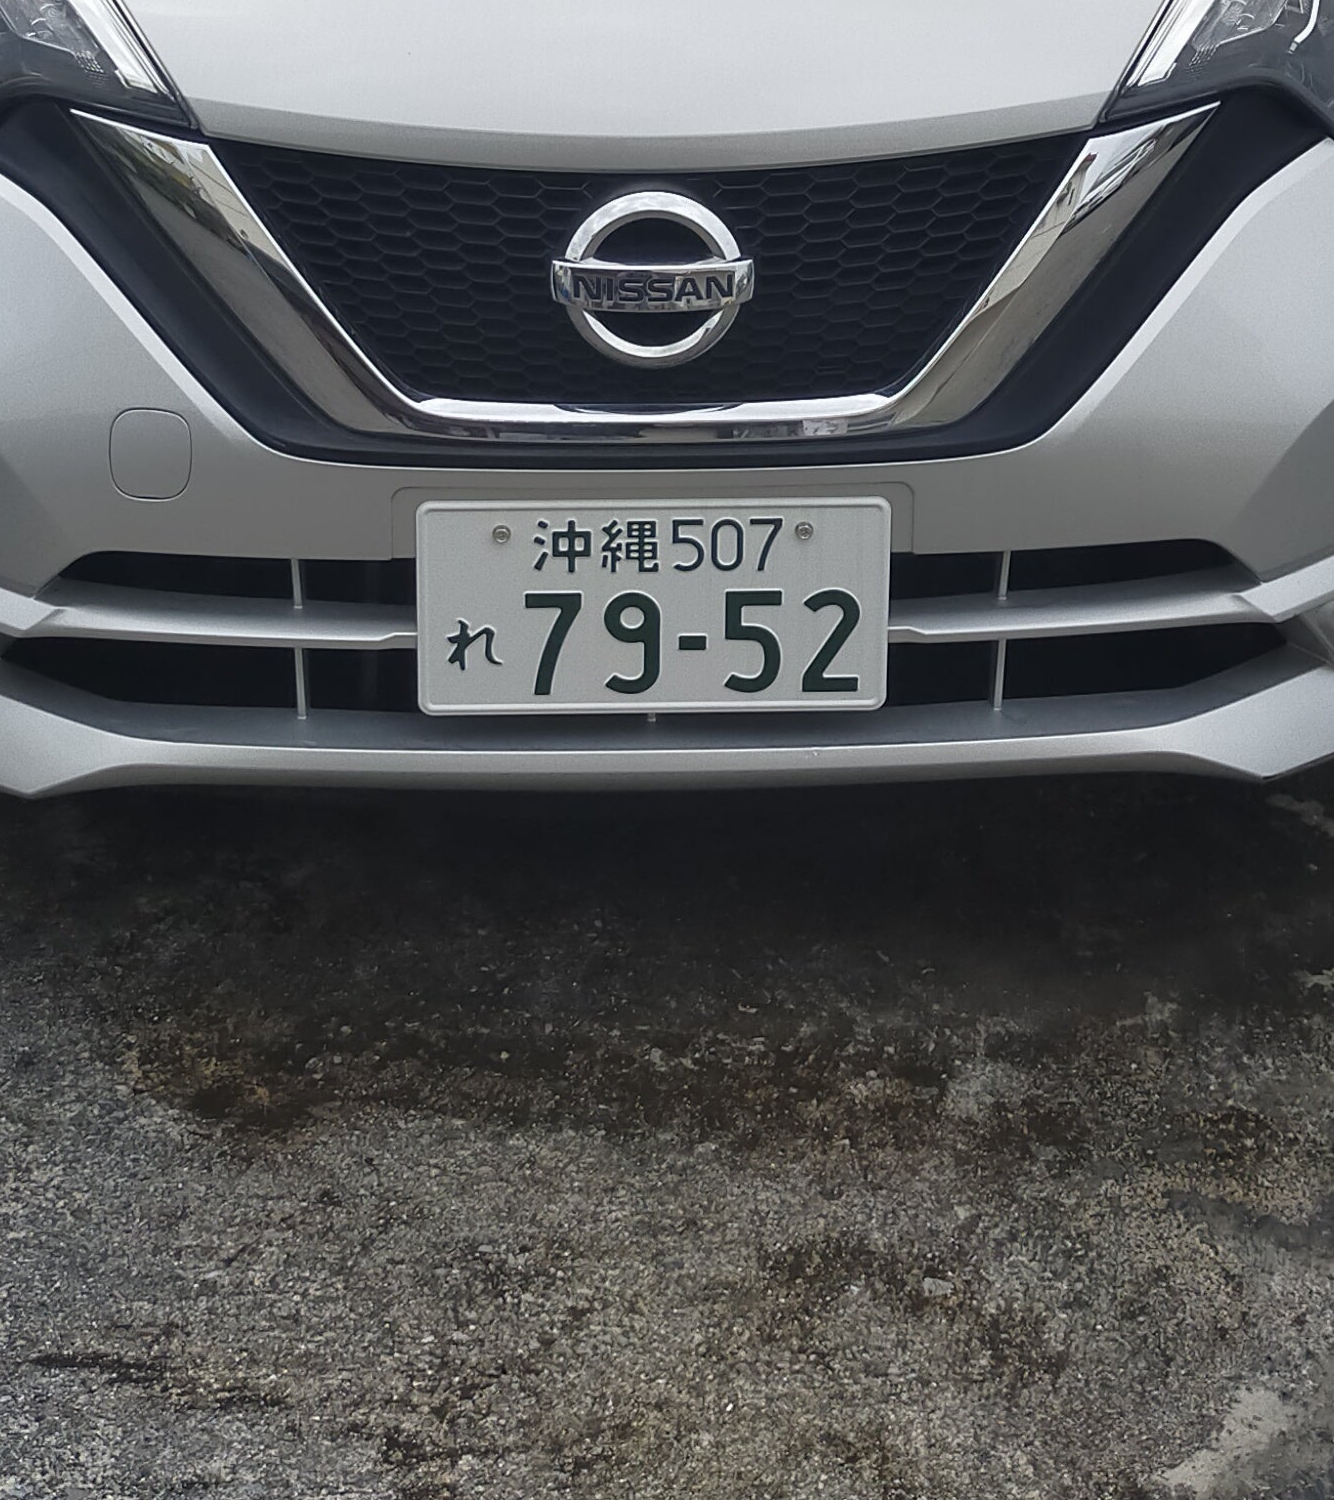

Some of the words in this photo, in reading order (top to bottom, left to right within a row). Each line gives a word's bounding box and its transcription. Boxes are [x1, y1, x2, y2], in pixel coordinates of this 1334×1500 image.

[572, 273, 735, 302] NISSAN
[446, 617, 504, 671] れ
[523, 587, 862, 697] 79-52
